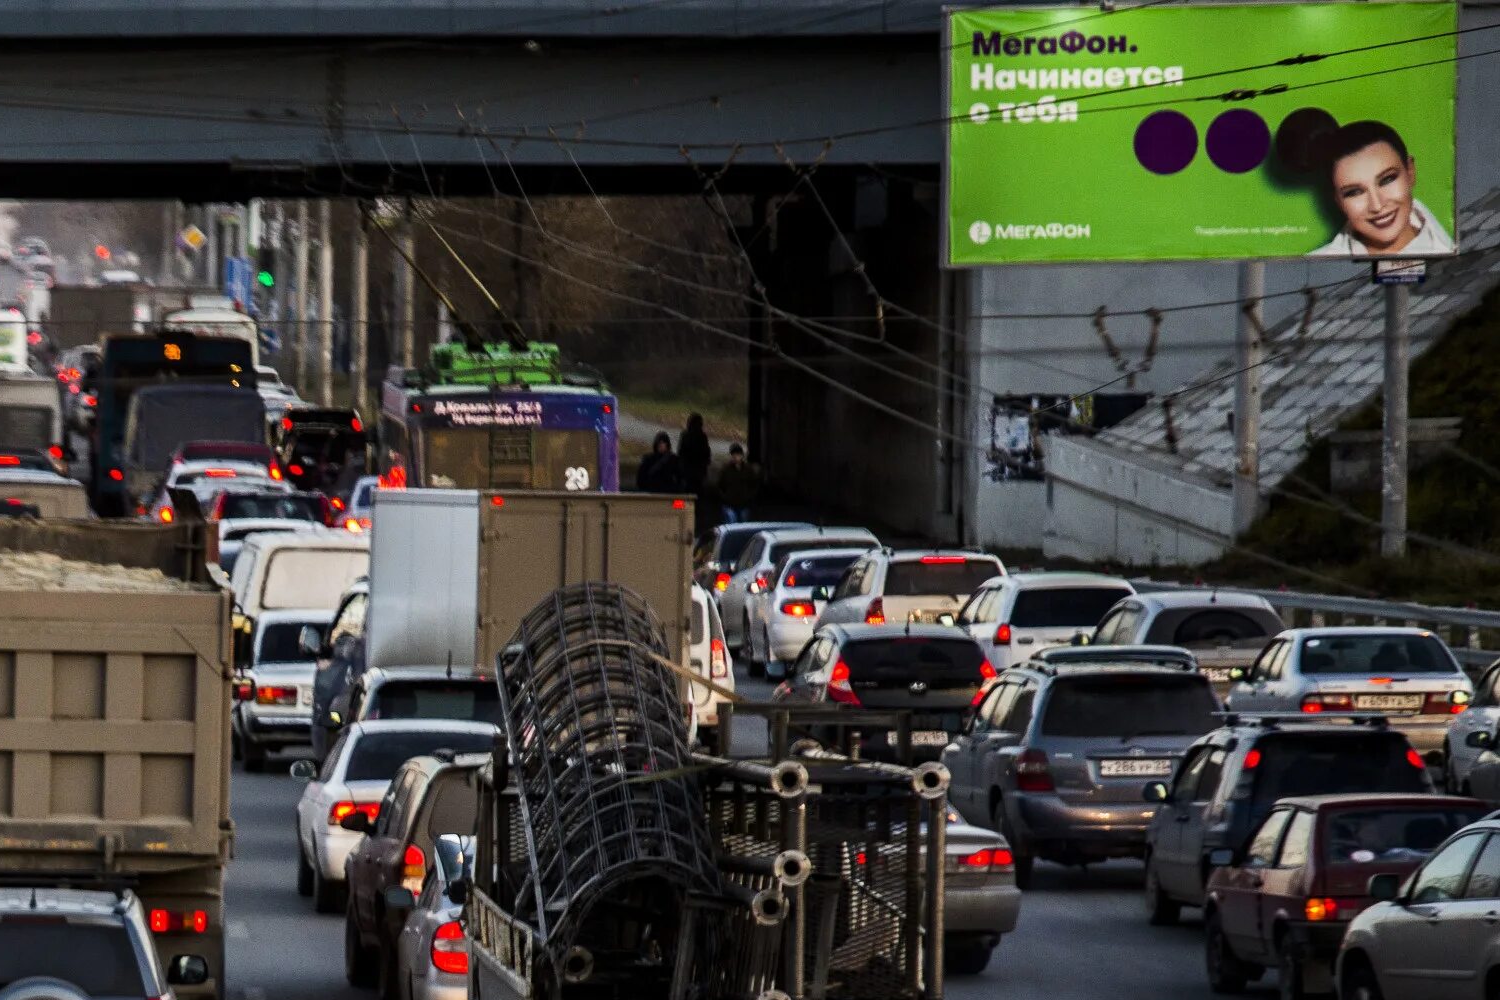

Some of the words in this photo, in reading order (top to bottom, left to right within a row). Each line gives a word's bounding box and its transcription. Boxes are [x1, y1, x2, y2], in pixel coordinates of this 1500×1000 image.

[972, 30, 1138, 56] МегаФон.
[971, 63, 1183, 90] Начинается
[969, 102, 990, 124] с
[998, 95, 1078, 123] тебя
[995, 223, 1091, 240] МЕГАФОН
